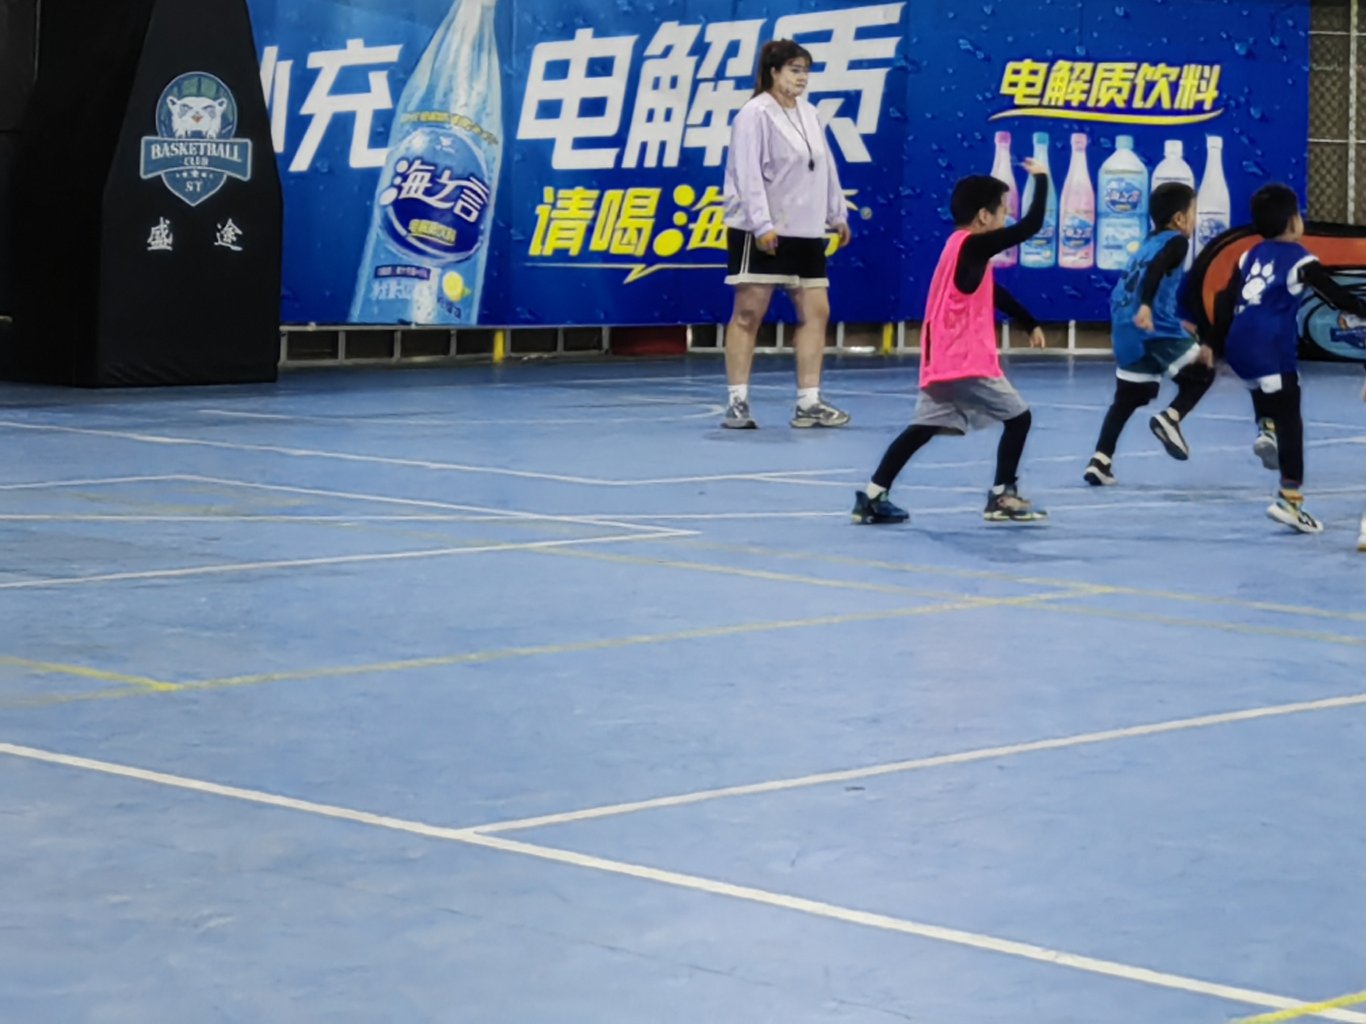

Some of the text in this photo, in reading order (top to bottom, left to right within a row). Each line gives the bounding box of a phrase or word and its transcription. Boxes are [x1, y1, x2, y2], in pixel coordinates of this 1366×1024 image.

[999, 59, 1222, 111] 电解质饮料
[151, 142, 243, 163] BASKETBALL
[185, 180, 203, 192] ST
[379, 159, 490, 223] 海之言
